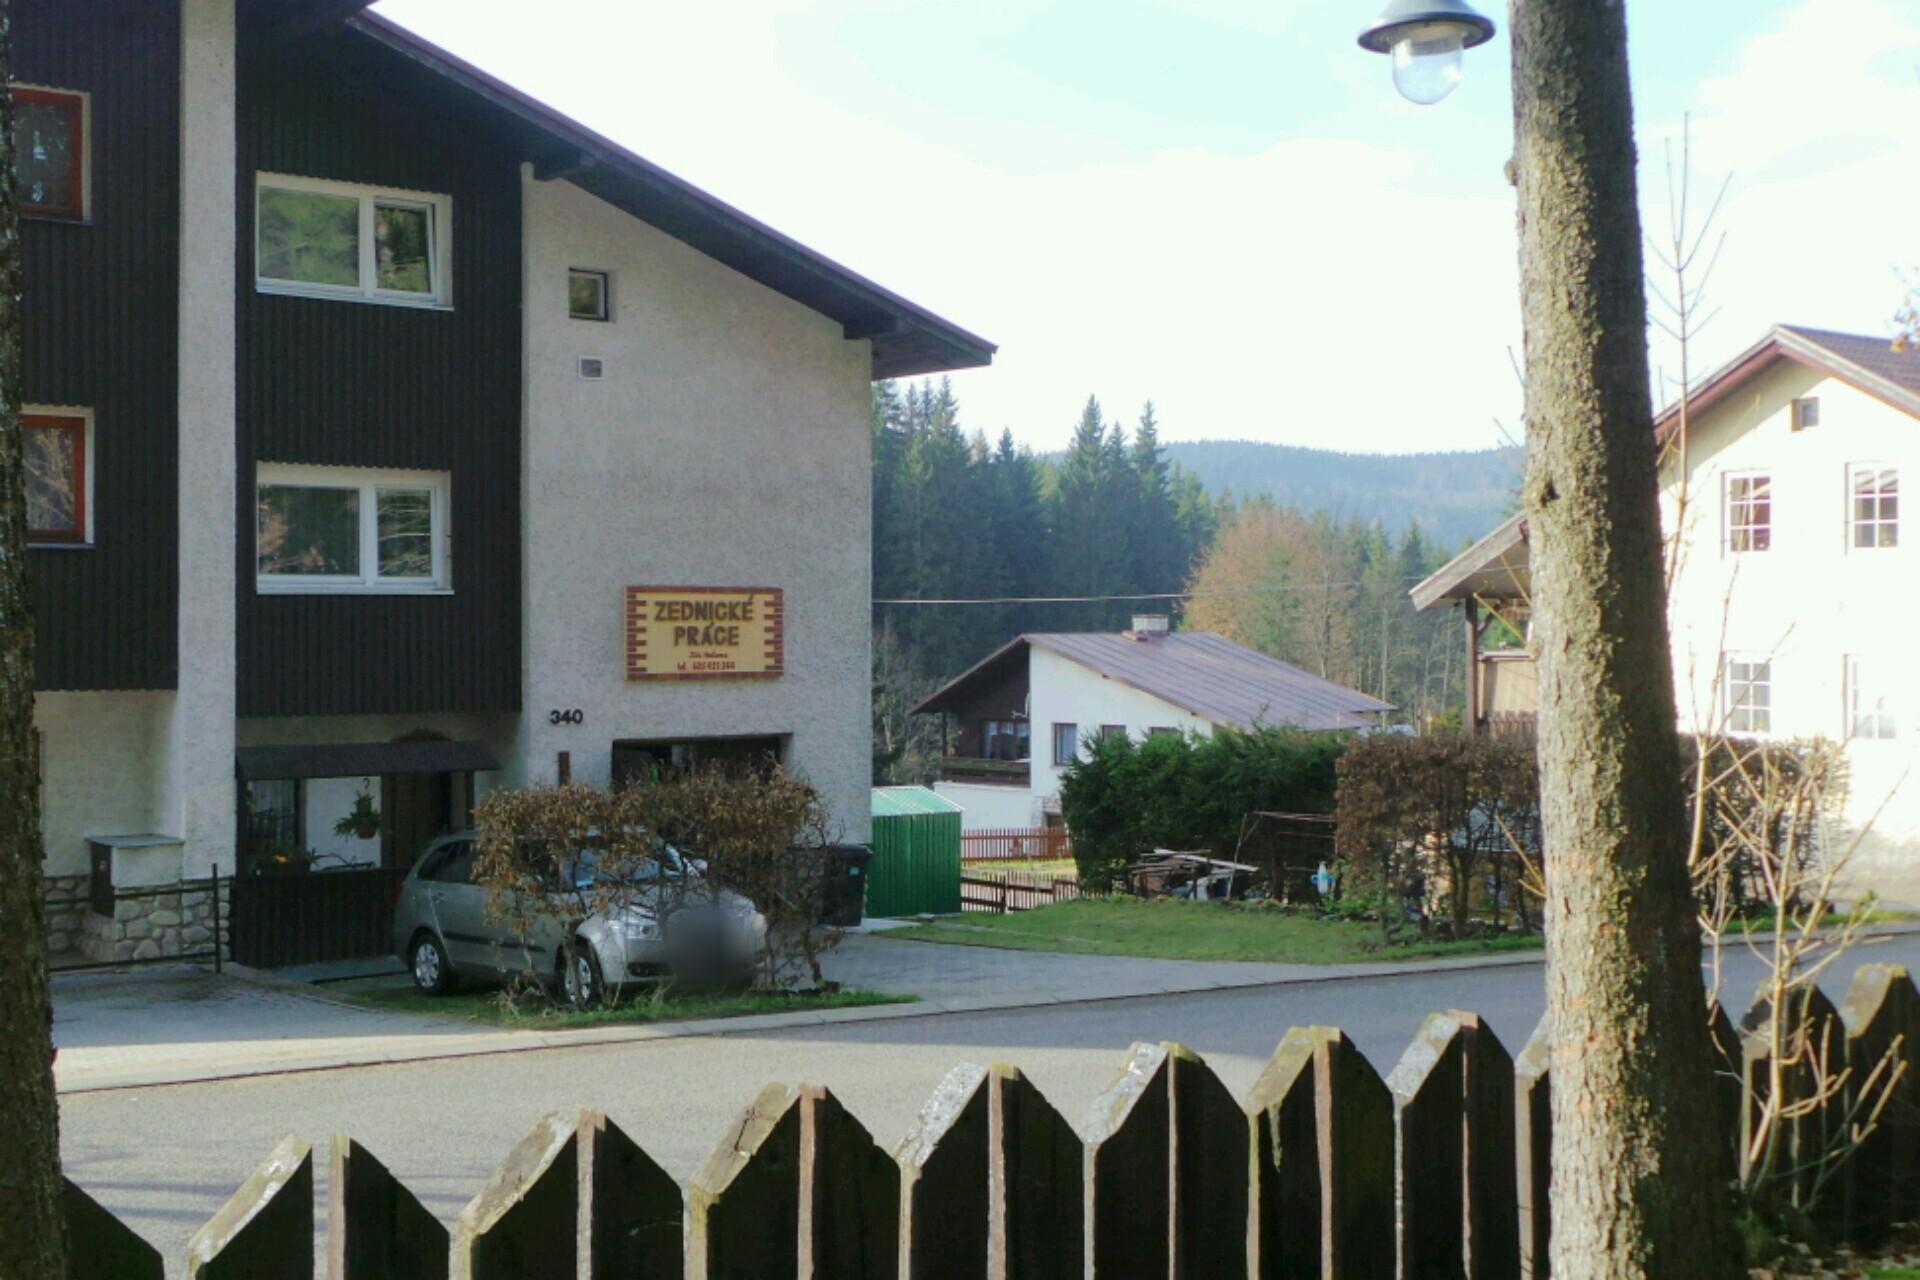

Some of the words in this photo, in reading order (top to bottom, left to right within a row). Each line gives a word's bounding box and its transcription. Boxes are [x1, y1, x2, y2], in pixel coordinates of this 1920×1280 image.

[655, 594, 754, 621] ZEDNICKÉ
[674, 623, 740, 647] PRÁCE
[548, 708, 584, 724] 340
